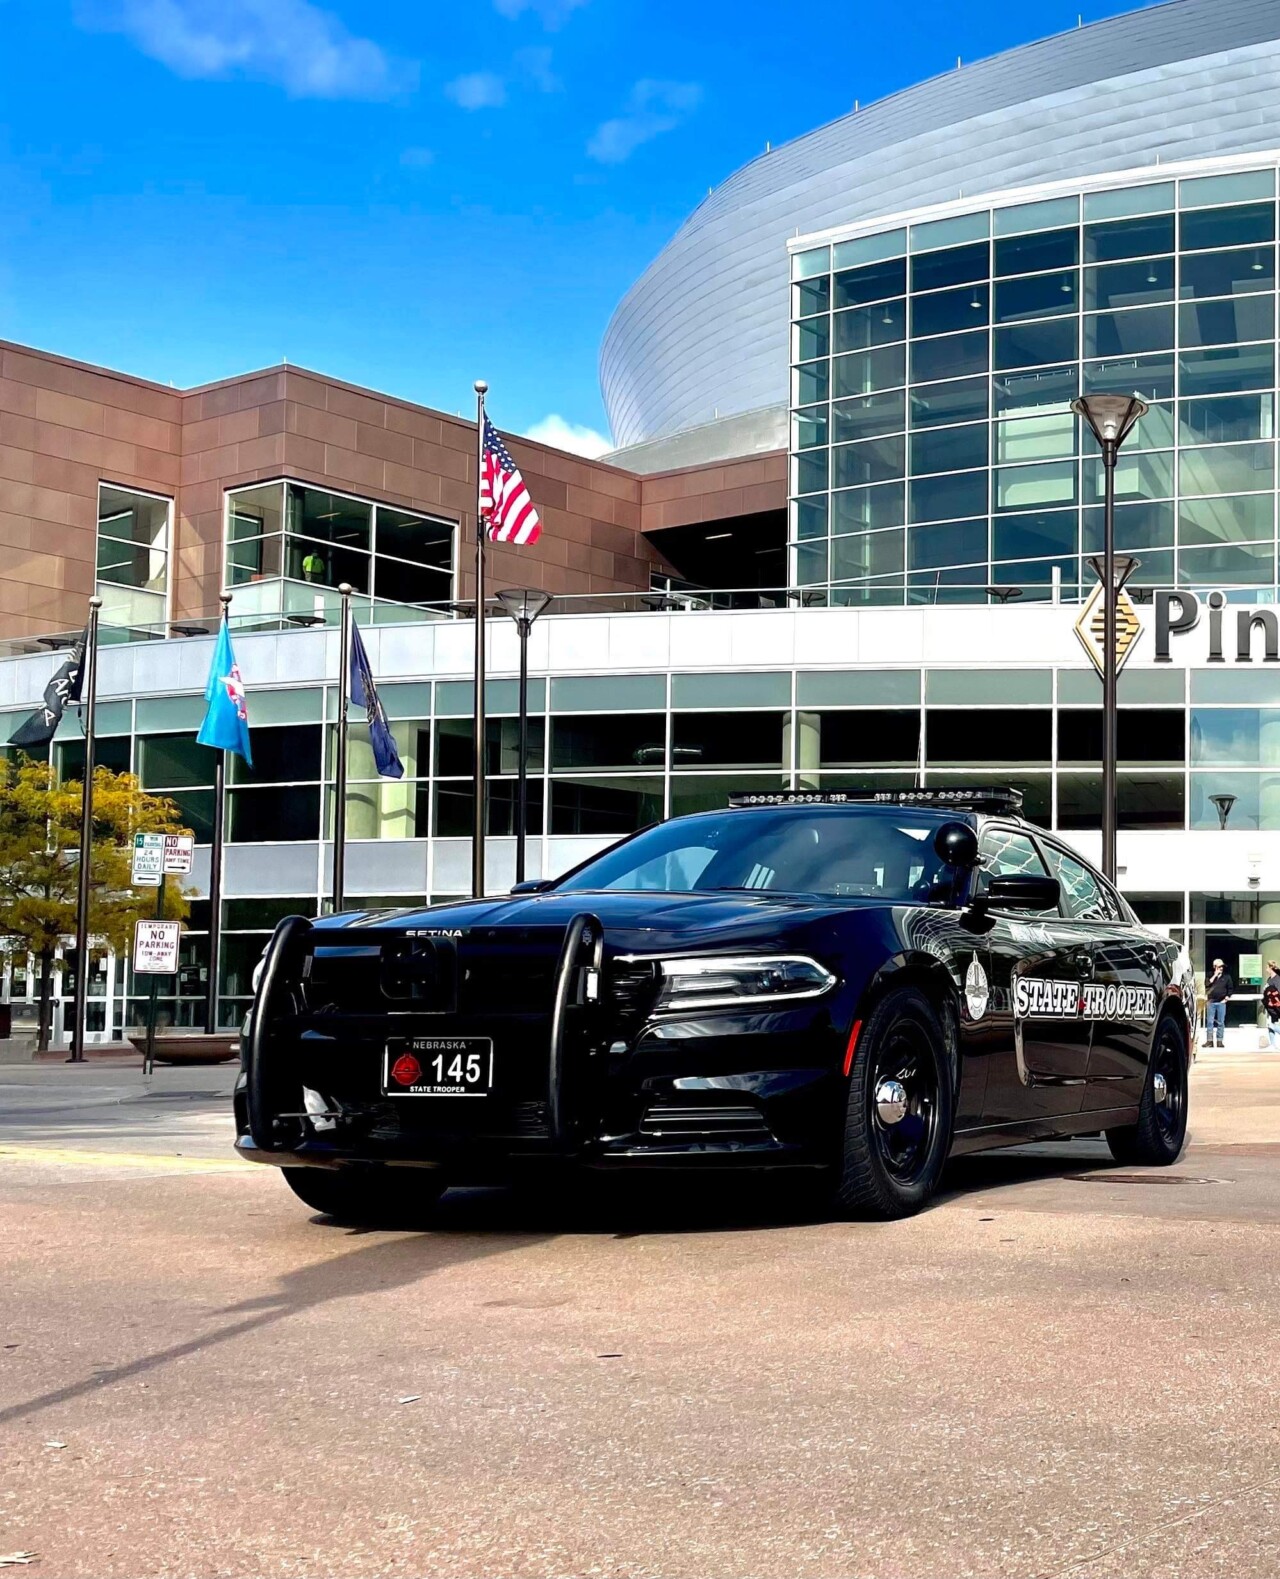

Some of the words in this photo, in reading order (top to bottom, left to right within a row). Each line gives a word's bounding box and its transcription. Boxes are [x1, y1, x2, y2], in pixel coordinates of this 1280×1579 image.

[166, 837, 178, 847] NO
[165, 849, 191, 857] PARKING
[150, 930, 165, 940] NO
[405, 929, 463, 938] SETINA
[139, 940, 175, 950] PARKING
[1015, 977, 1080, 1017] STATE
[1083, 983, 1156, 1020] TROOPER
[412, 1041, 467, 1050] NEBRASKA
[431, 1053, 481, 1083] 145
